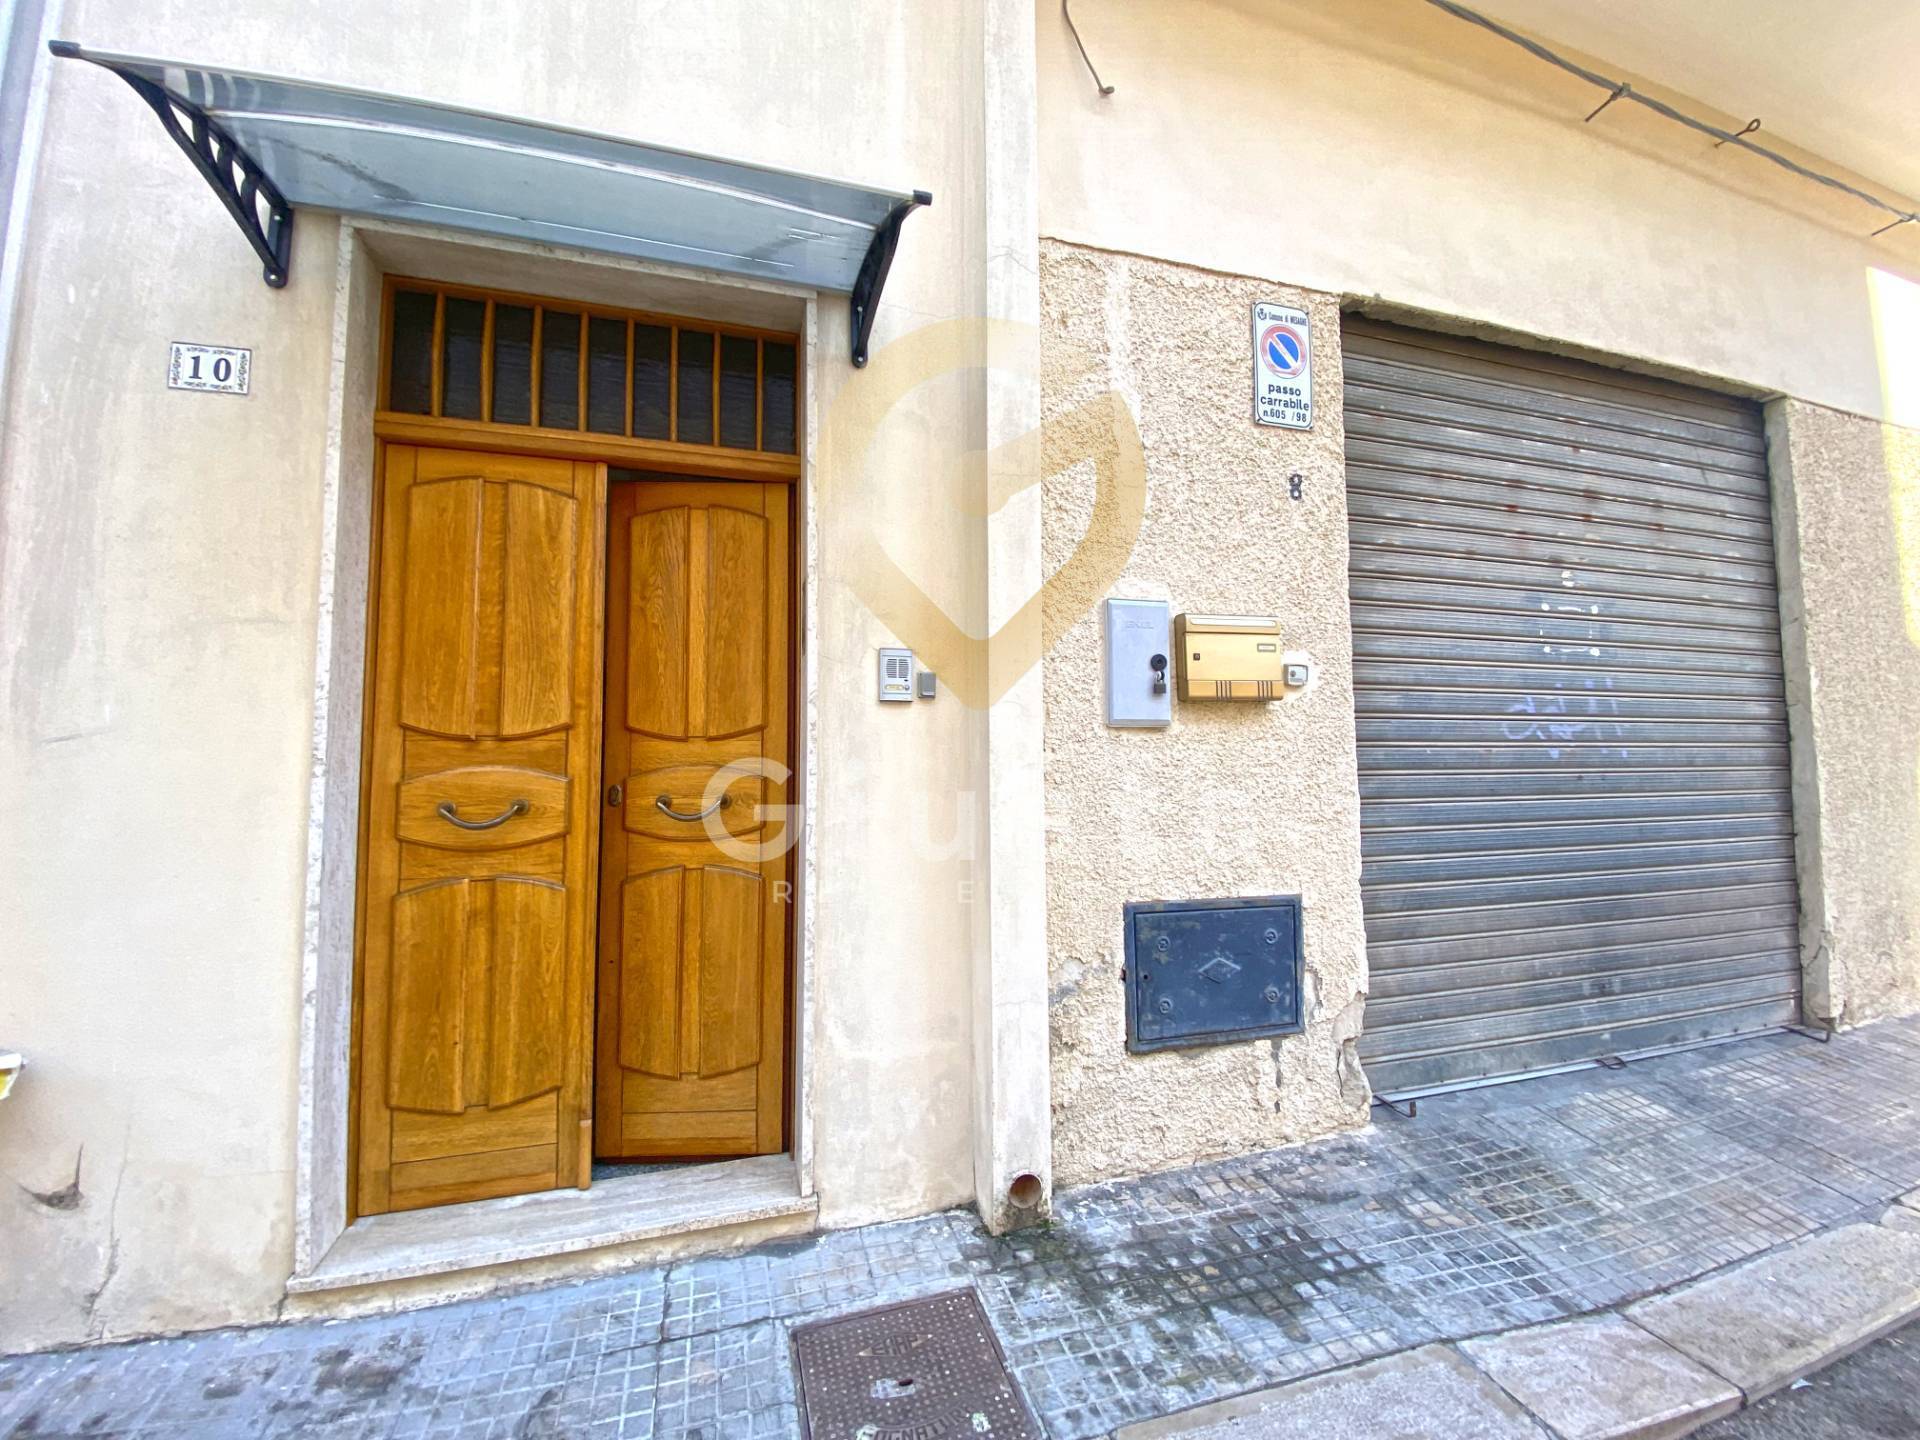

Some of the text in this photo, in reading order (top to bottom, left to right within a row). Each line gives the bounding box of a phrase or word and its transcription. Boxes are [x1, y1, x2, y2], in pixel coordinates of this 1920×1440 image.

[188, 355, 232, 382] 10
[1268, 384, 1302, 396] passo
[1260, 396, 1310, 411] carrabile
[1289, 473, 1302, 500] 8
